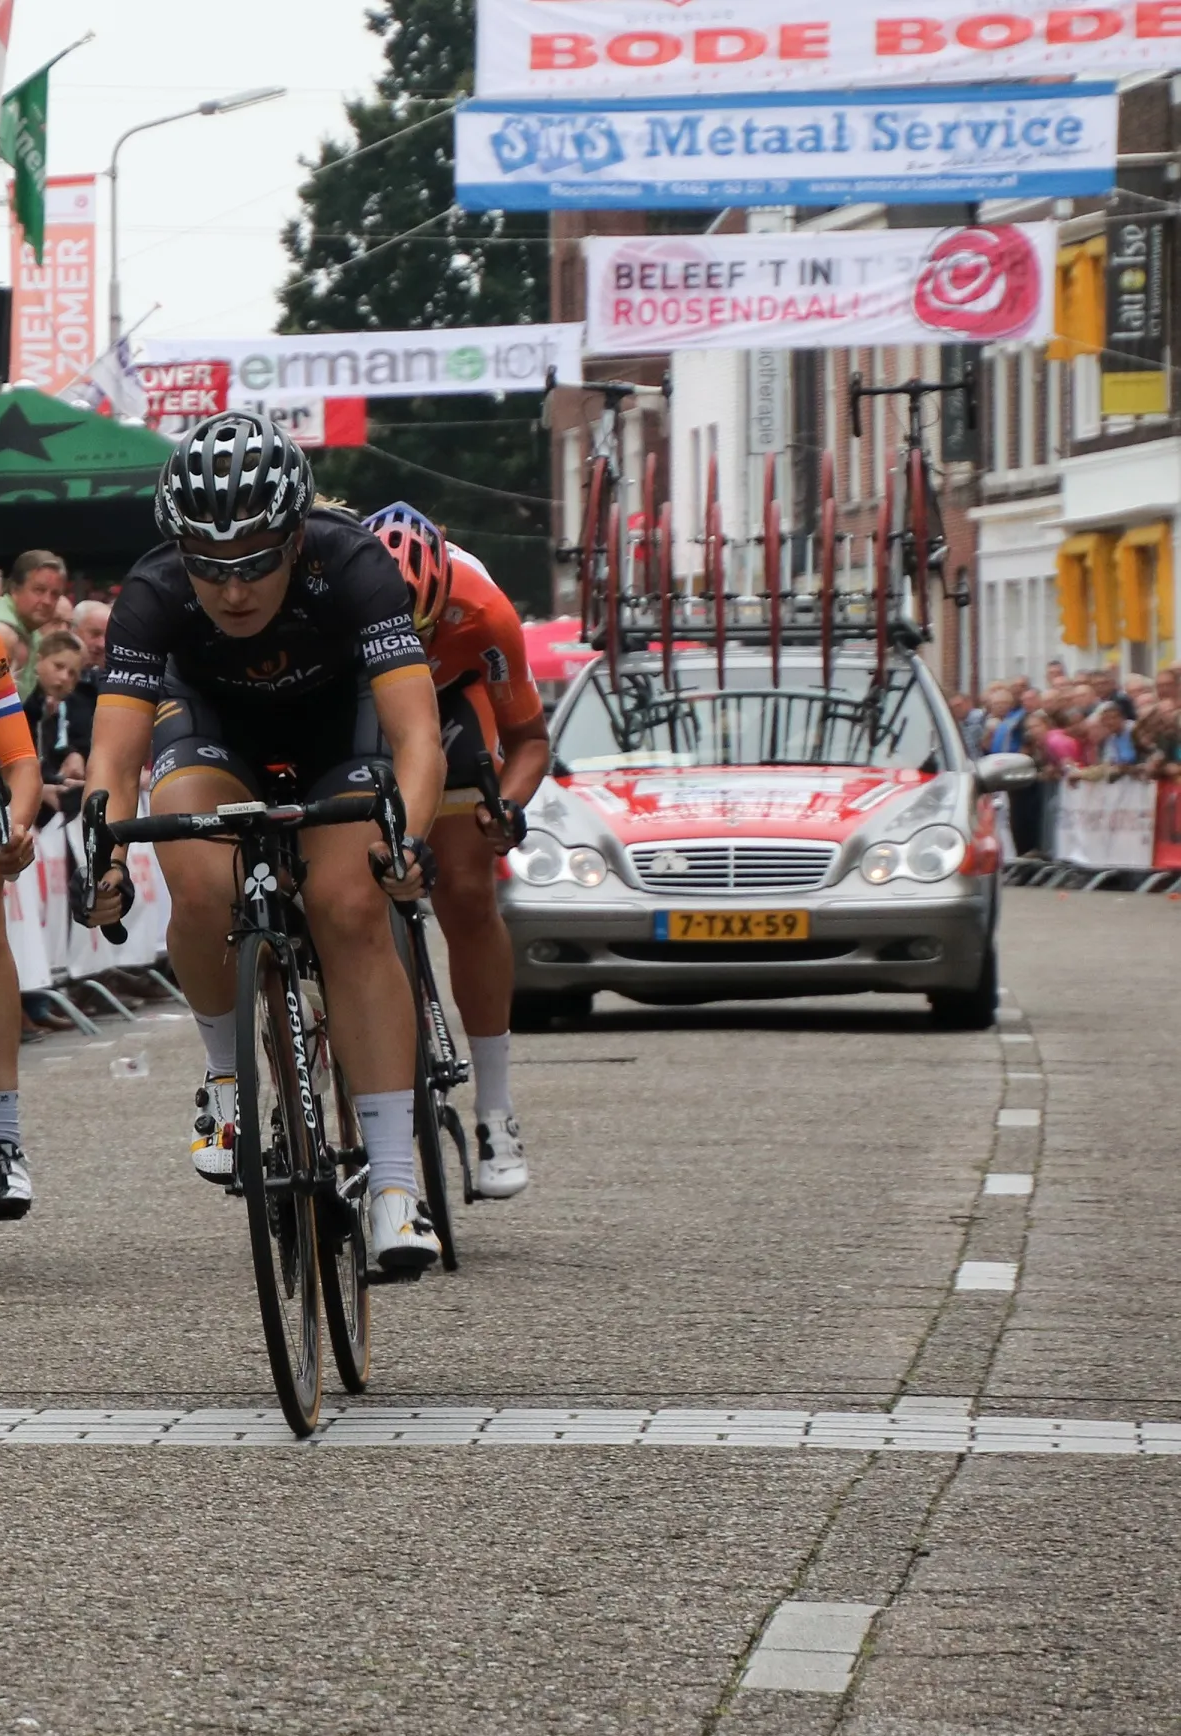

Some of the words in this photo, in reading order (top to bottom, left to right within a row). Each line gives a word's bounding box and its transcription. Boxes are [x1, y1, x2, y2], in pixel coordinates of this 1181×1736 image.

[529, 21, 830, 71] BODE
[875, 1, 1181, 56] BODE
[644, 110, 849, 157] Metaal
[872, 107, 1084, 152] Service
[615, 259, 744, 290] BELEEF
[800, 258, 834, 286] IN
[56, 238, 89, 377] ZOMER
[614, 293, 859, 326] ROOSENDAAL!
[138, 365, 213, 388] OVER
[239, 346, 437, 391] erman
[147, 389, 219, 412] TEEK
[678, 913, 798, 936] 7-TXX-59
[286, 990, 317, 1130] COLNAGO
